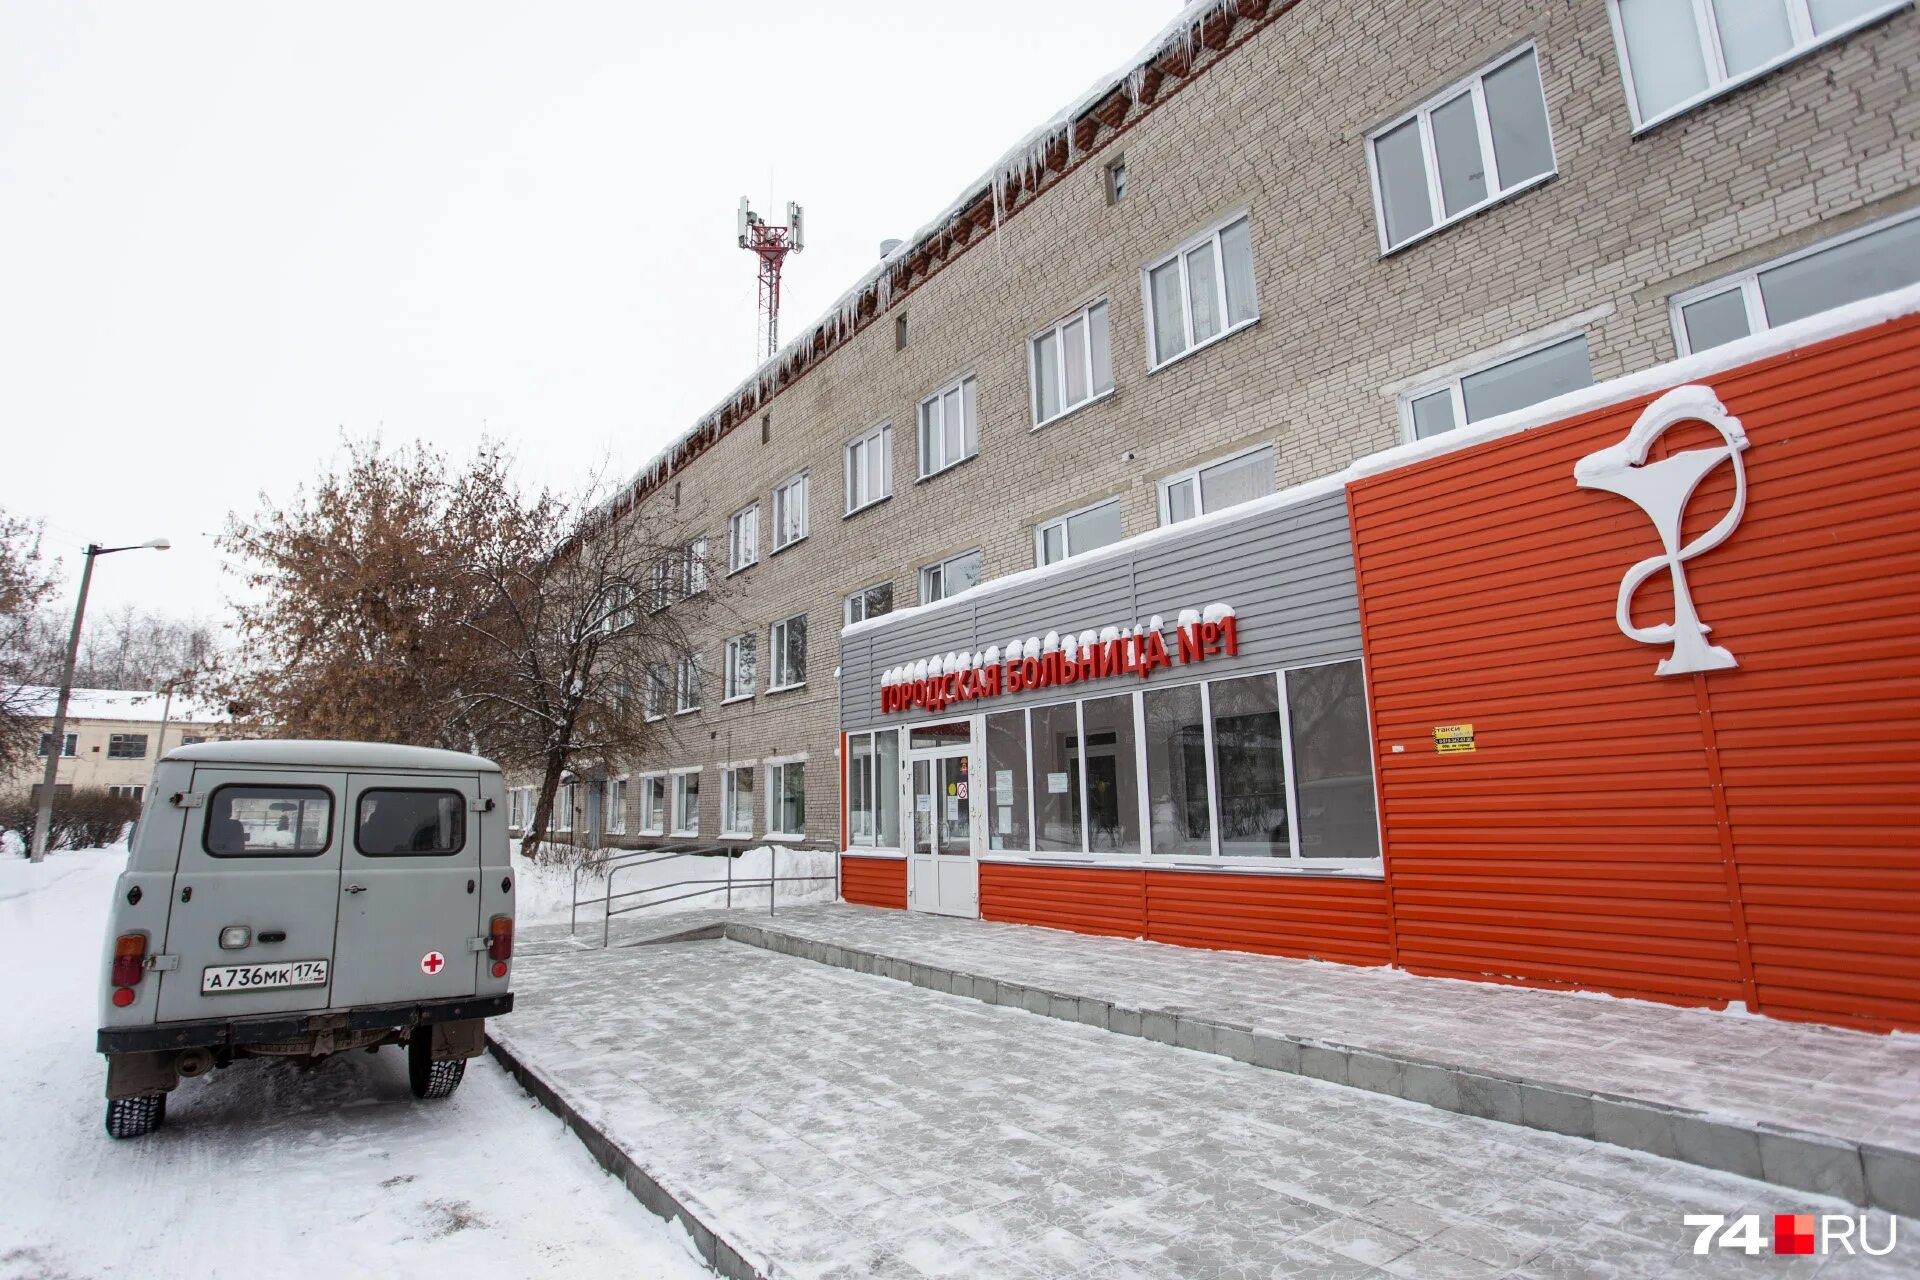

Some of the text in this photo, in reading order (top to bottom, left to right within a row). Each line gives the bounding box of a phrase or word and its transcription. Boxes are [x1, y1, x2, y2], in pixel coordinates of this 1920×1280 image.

[881, 616, 1238, 713] ГОРОДСКАЯ БОЛЬНИЦА №1
[294, 963, 324, 978] 174
